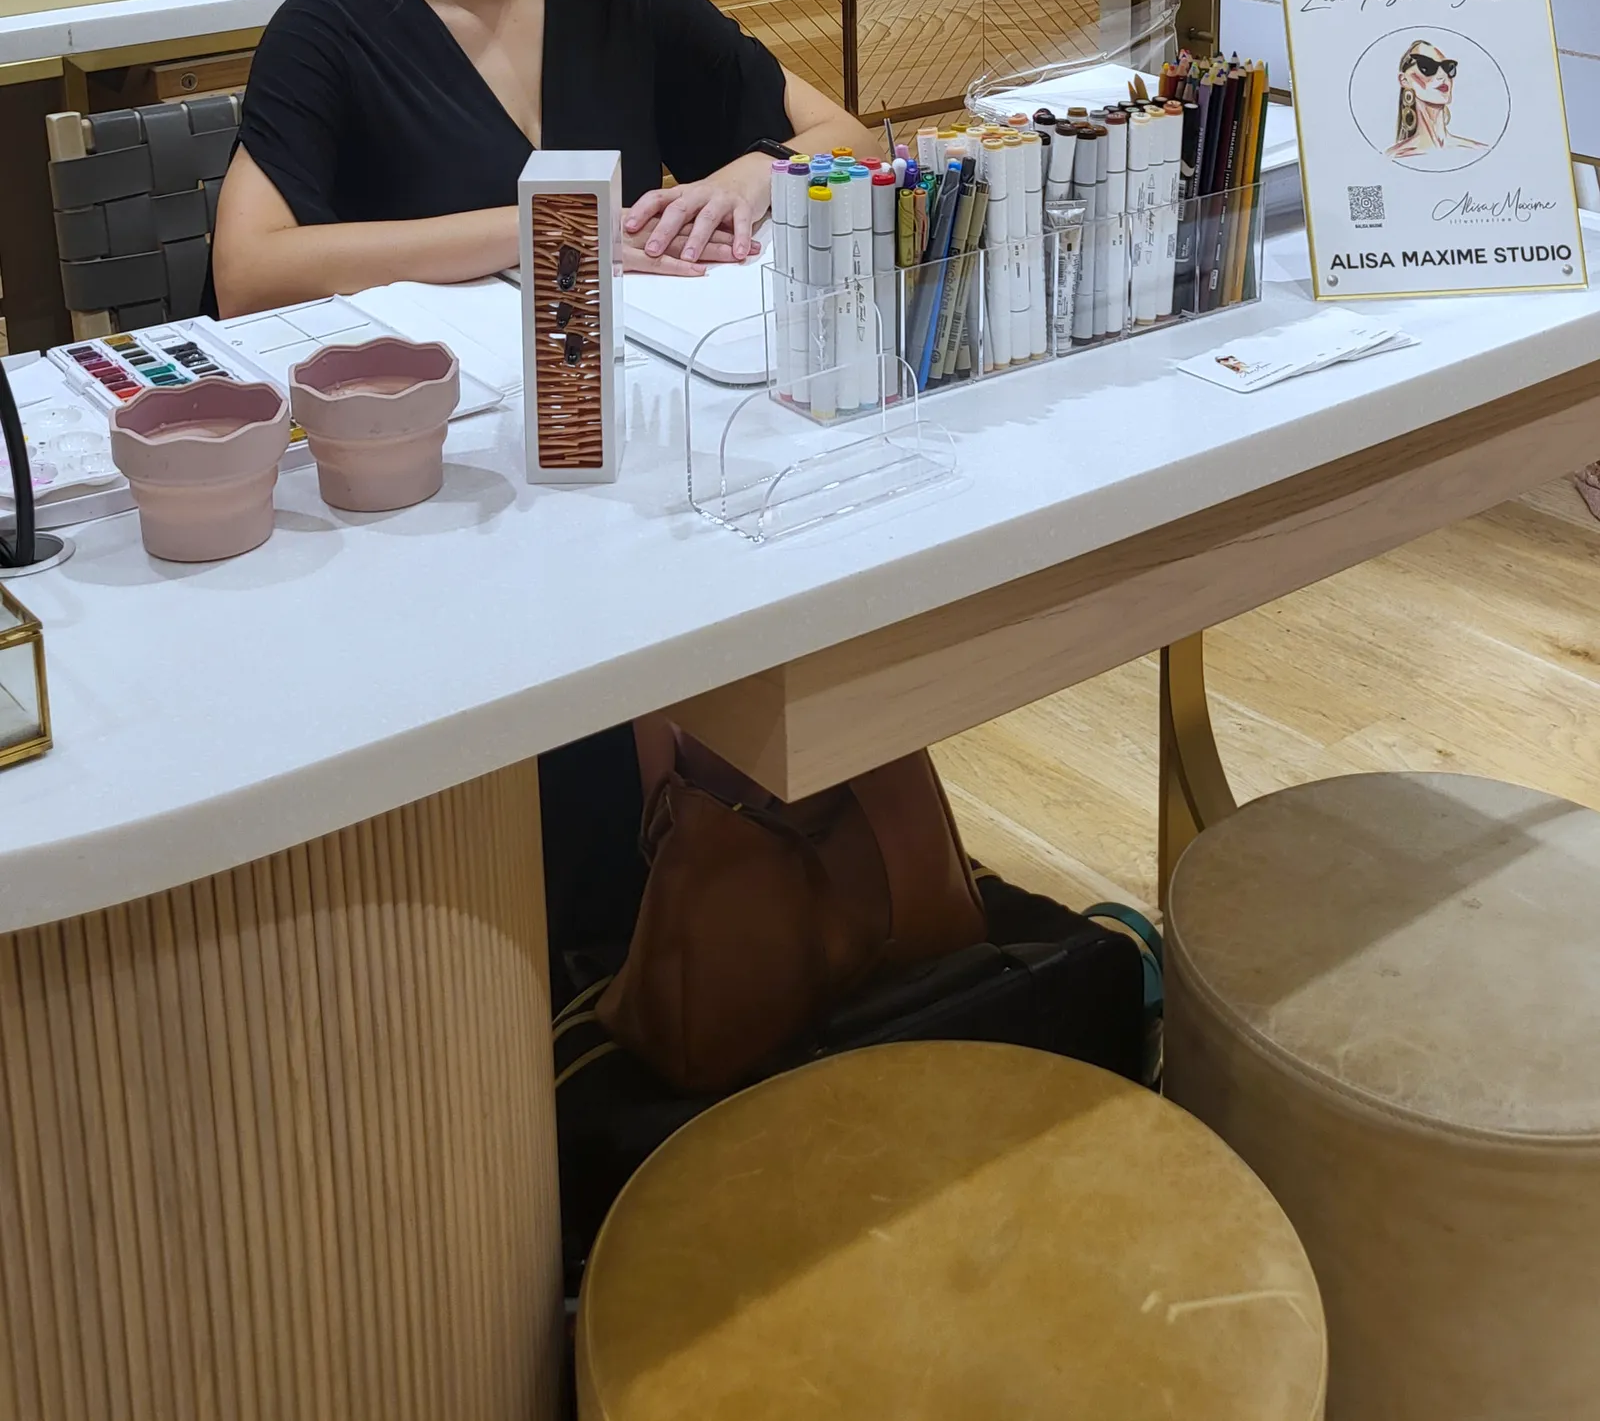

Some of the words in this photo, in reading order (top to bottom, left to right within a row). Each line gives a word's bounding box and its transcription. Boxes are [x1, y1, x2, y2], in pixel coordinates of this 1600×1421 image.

[1431, 191, 1494, 222] Alisa
[1491, 186, 1557, 222] Maxime
[1330, 252, 1395, 270] ALISA
[1402, 248, 1488, 267] MAXIME
[1494, 245, 1572, 263] STUDIO
